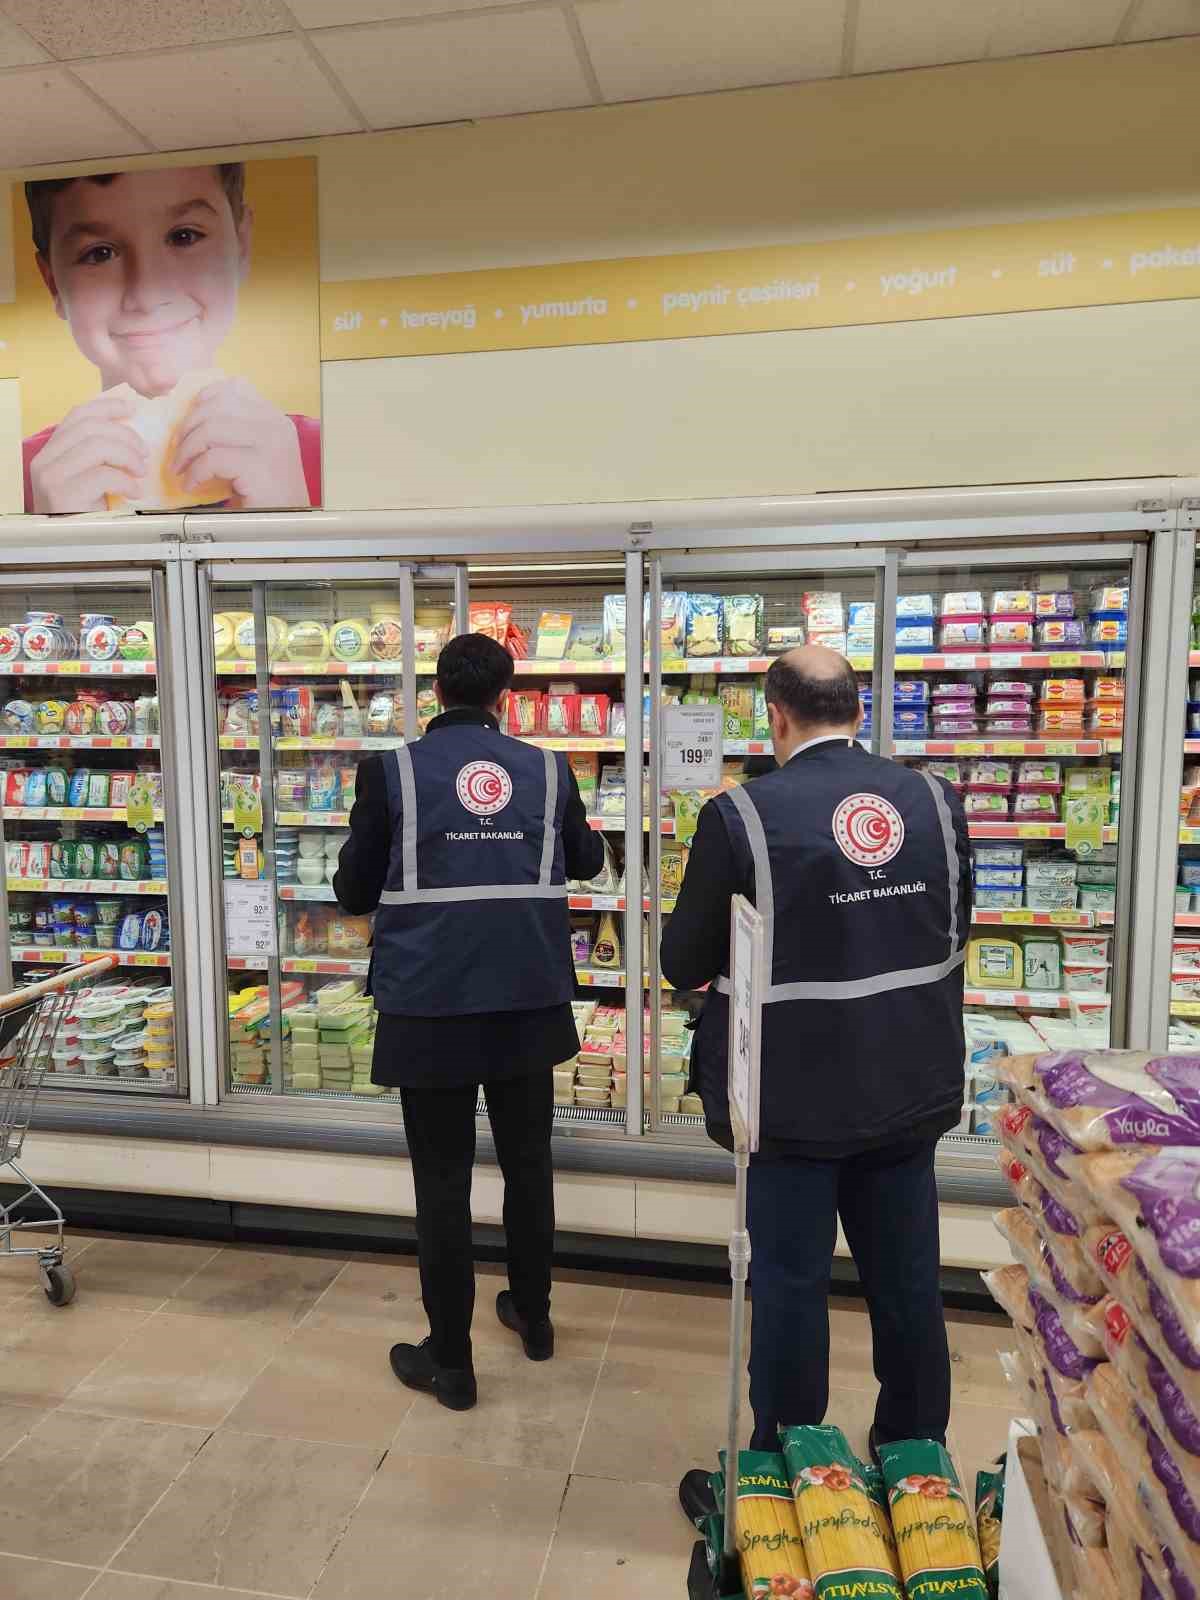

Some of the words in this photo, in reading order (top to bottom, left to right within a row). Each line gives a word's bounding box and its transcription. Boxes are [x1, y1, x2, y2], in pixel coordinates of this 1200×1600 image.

[519, 296, 608, 328] yumurta
[662, 281, 732, 319] peynir
[680, 749, 702, 764] 199
[445, 831, 480, 841] TİCARET
[480, 830, 524, 840] BAKANLIĞI
[868, 869, 887, 880] T.C.
[828, 890, 872, 905] TİCARET
[873, 881, 926, 898] BAKANLIĞI
[1113, 1117, 1170, 1138] Yayla
